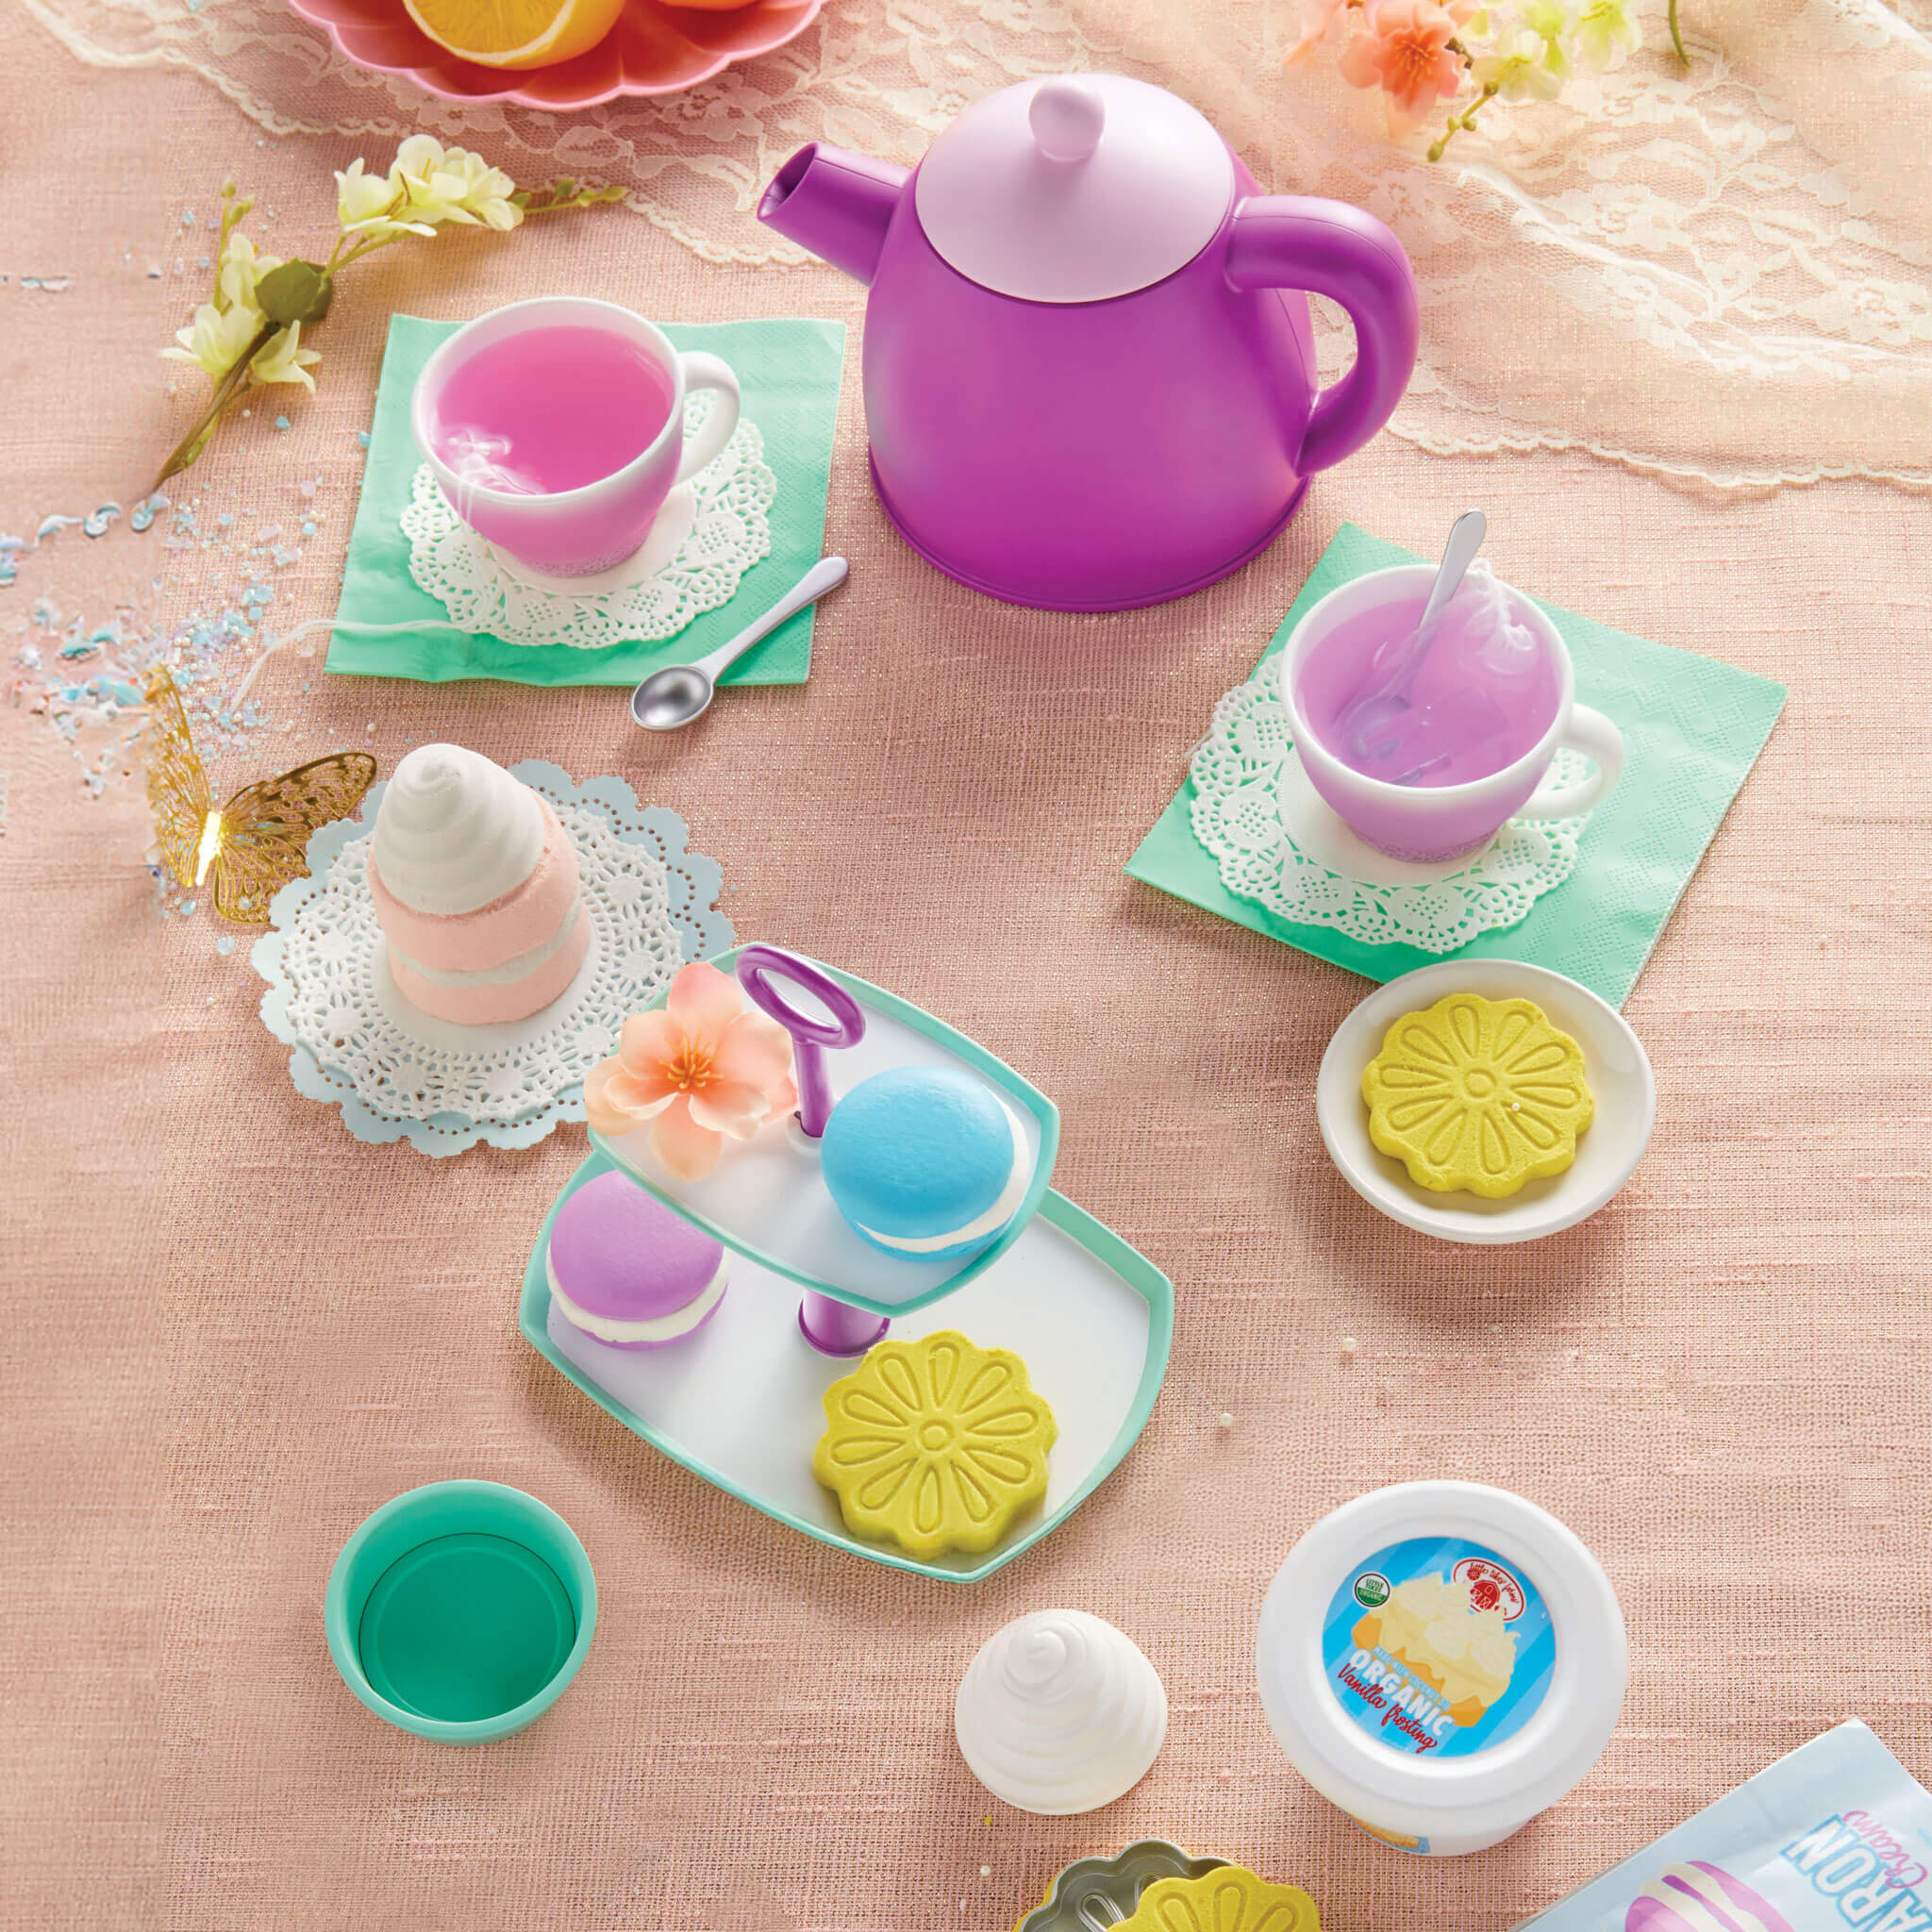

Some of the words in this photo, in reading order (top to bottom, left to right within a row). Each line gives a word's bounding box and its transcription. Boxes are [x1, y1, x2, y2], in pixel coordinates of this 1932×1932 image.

[1338, 1662, 1387, 1709] Vanilla
[1380, 1702, 1438, 1755] frosting
[1349, 1648, 1455, 1737] ORGANIC
